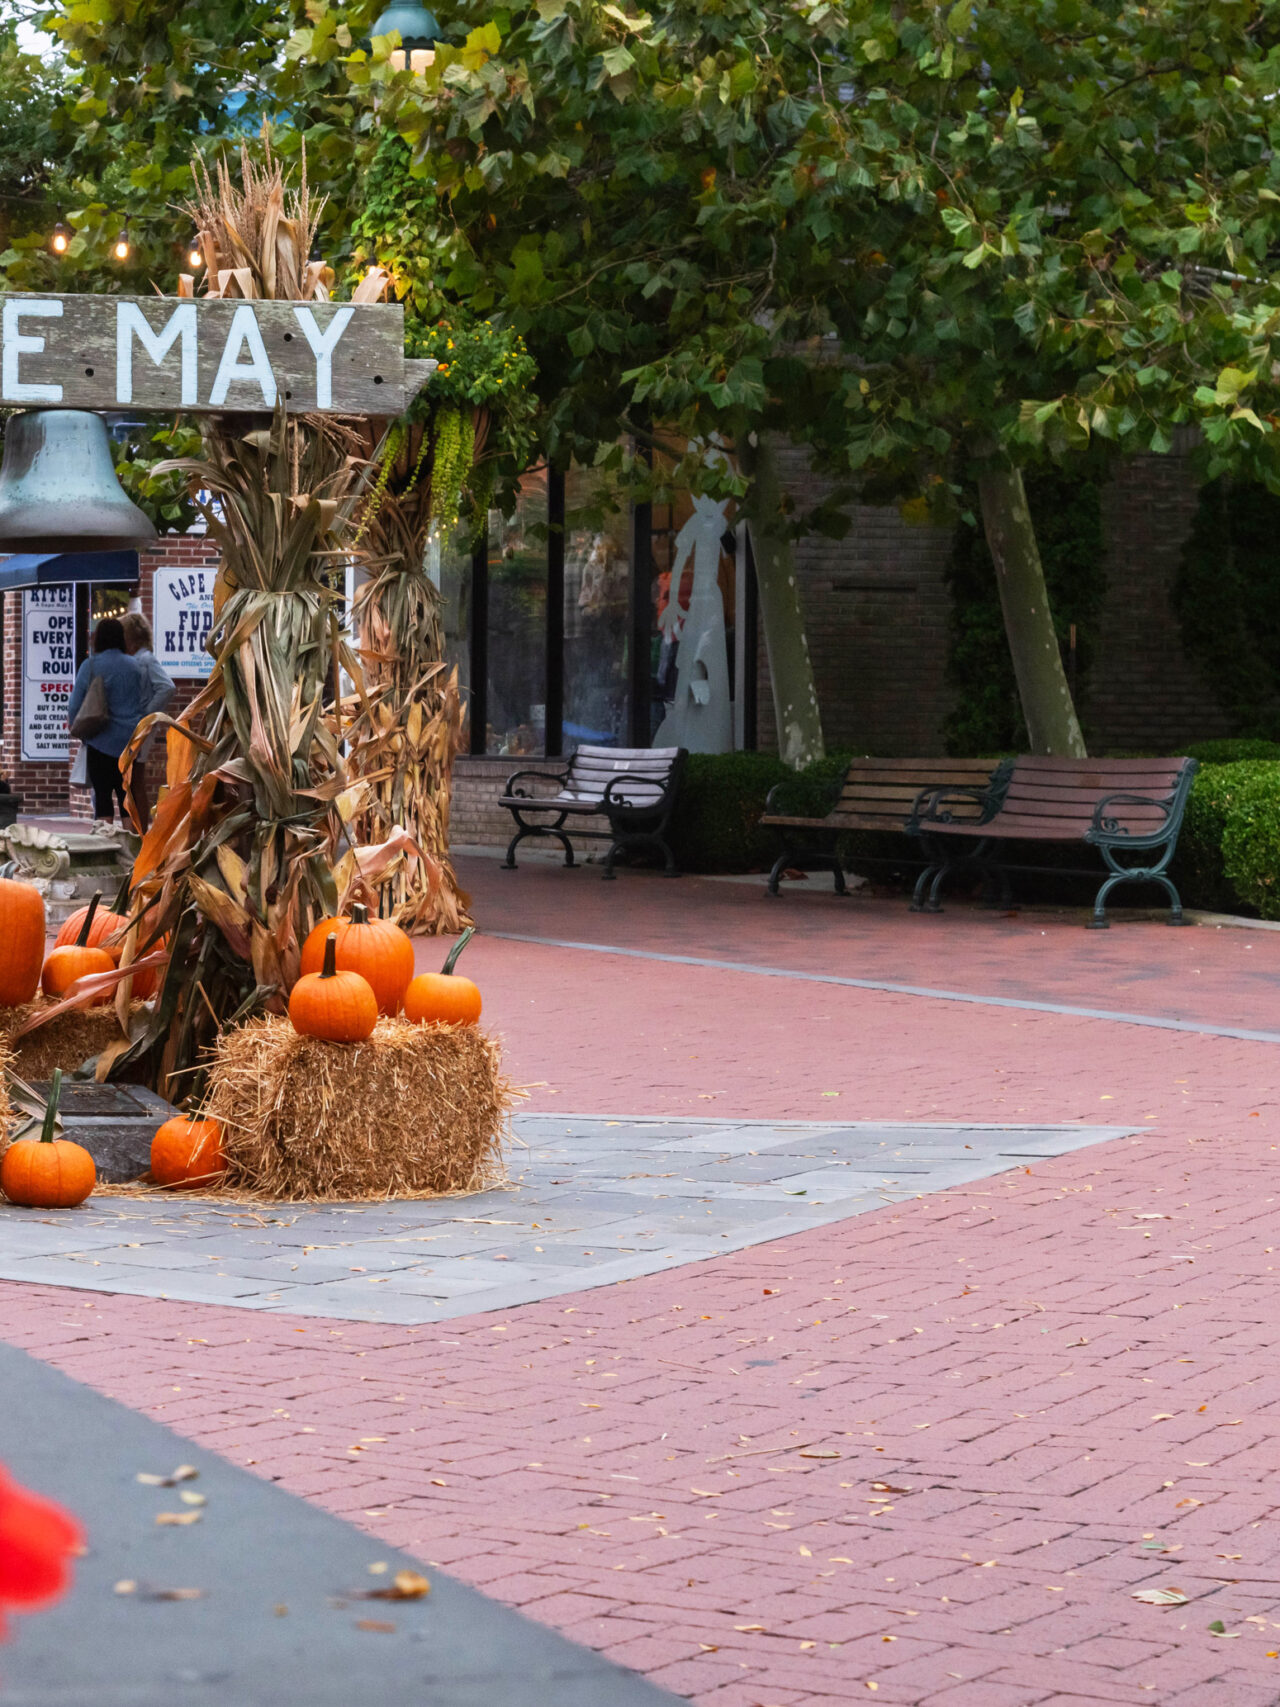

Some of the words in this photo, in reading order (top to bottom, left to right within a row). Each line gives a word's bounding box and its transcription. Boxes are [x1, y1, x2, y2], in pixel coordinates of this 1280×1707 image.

[116, 301, 356, 409] MAY
[168, 573, 205, 601] CAPE
[48, 616, 73, 629] OPE
[179, 611, 213, 631] FUD
[165, 631, 209, 652] KITC
[49, 646, 73, 660] YEA
[44, 693, 69, 703] TOD
[51, 742, 69, 750] WATE
